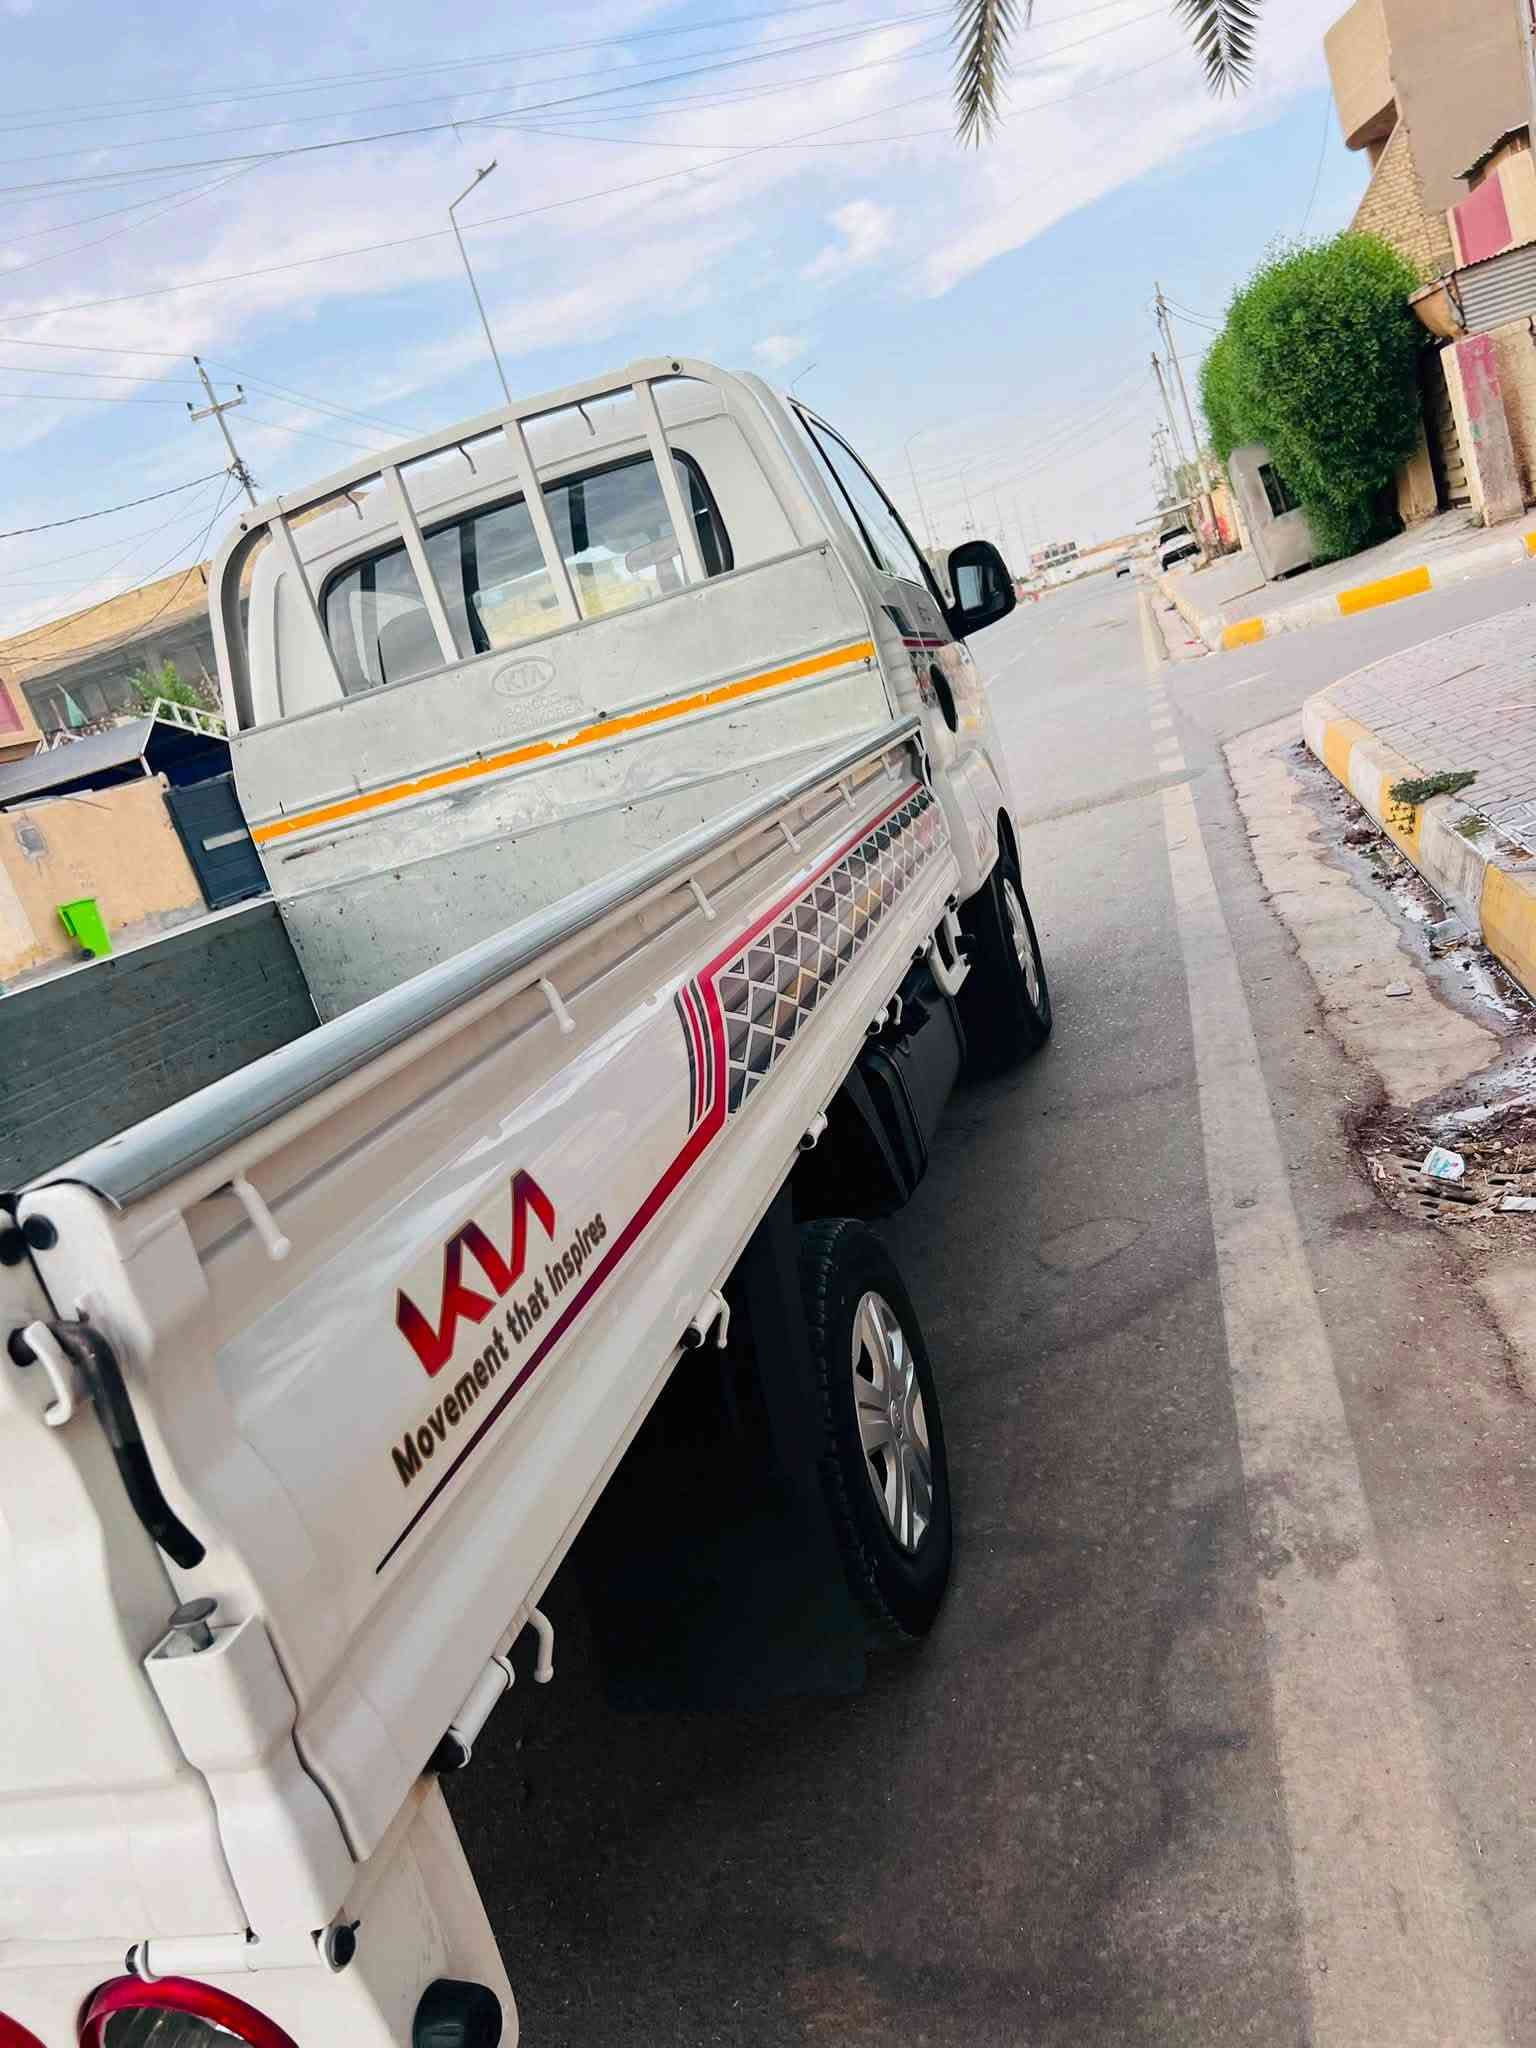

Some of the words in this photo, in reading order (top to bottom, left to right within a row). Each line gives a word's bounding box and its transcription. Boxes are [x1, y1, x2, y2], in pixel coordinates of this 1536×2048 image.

[391, 1326, 508, 1487] Movement
[506, 1277, 549, 1343] that
[545, 1213, 607, 1297] inspires
